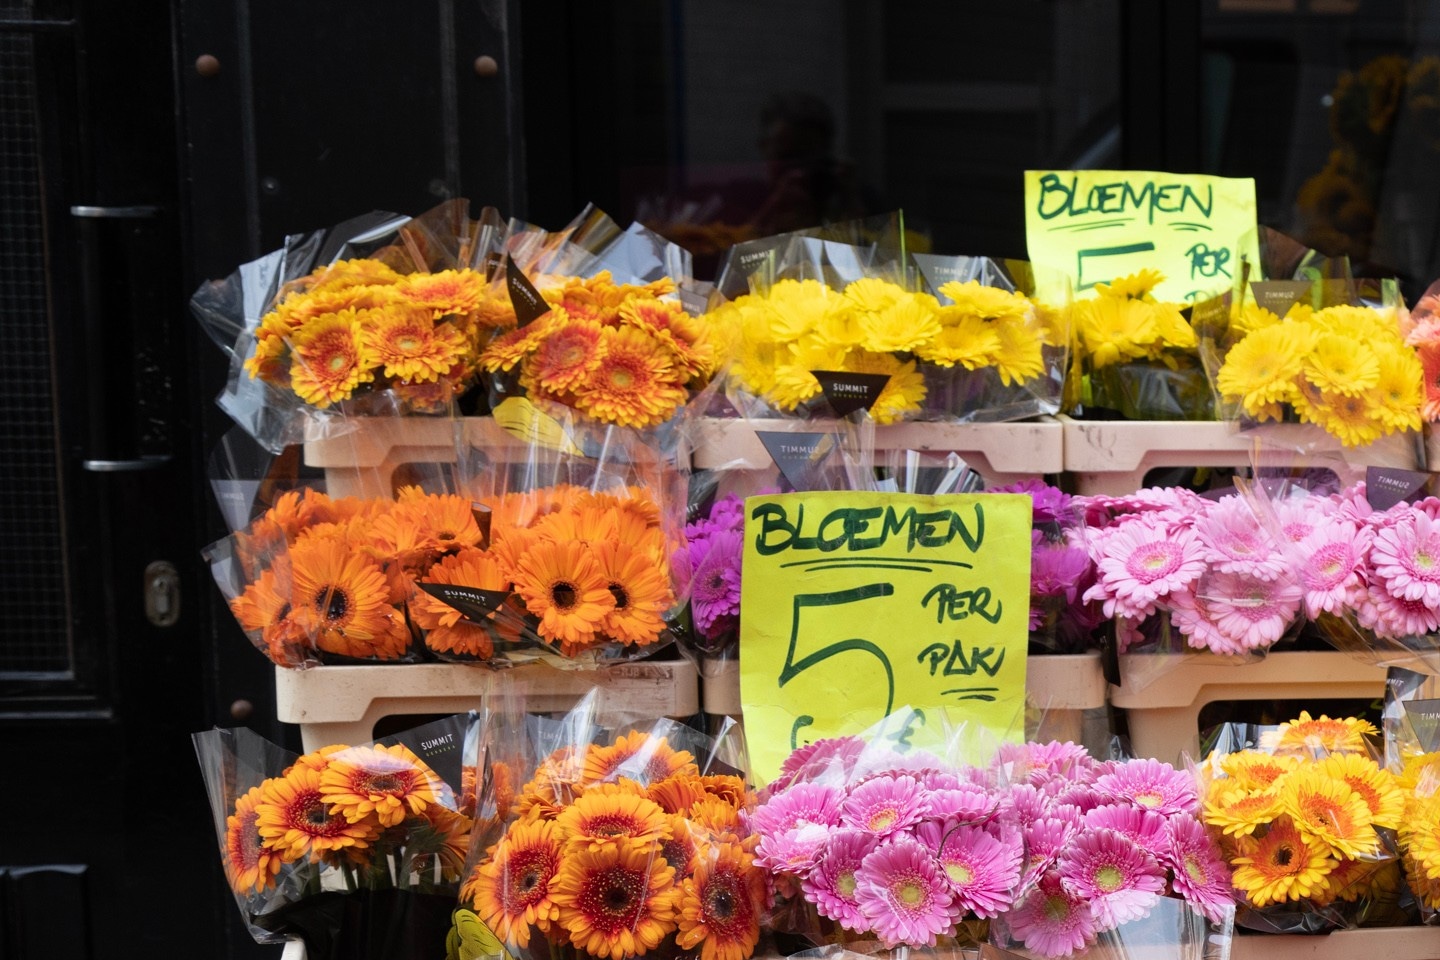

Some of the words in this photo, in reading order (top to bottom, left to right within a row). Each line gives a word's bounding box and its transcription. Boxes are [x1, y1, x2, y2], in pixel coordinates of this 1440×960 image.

[1038, 174, 1213, 225] BLOEMEN
[1185, 242, 1232, 280] PER
[833, 383, 868, 394] SUMMIT
[752, 501, 985, 556] BLOEMEN
[444, 590, 485, 603] SUMMIT
[778, 582, 895, 752] 5
[921, 583, 1002, 625] PER
[917, 640, 1005, 677] PAK
[421, 733, 453, 751] SUMMIT
